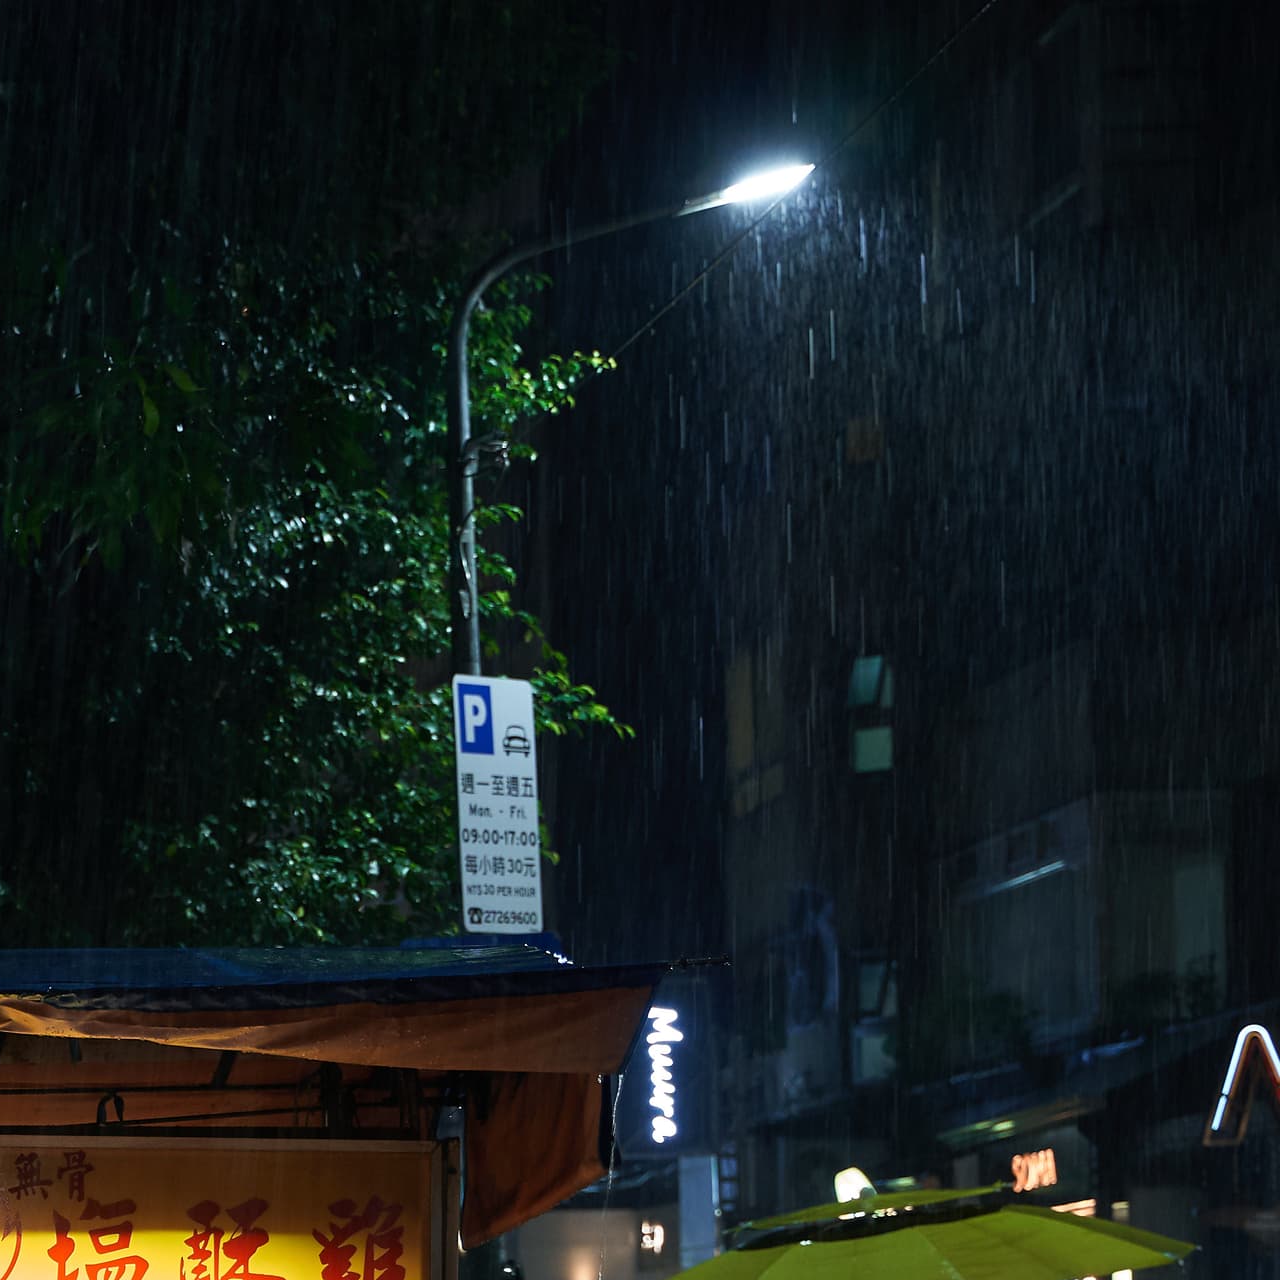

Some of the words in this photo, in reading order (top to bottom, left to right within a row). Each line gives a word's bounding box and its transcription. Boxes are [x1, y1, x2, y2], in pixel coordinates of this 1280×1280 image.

[463, 694, 487, 743] P
[461, 773, 534, 798] 週一至週五
[469, 804, 493, 818] Mon.
[510, 806, 527, 819] Fri.
[462, 828, 537, 847] 09:00-17:00
[465, 855, 537, 877] 每小時30元
[497, 886, 513, 897] PER
[514, 887, 536, 898] HOUR
[484, 910, 537, 925] 27269600
[8, 1150, 95, 1203] 無骨
